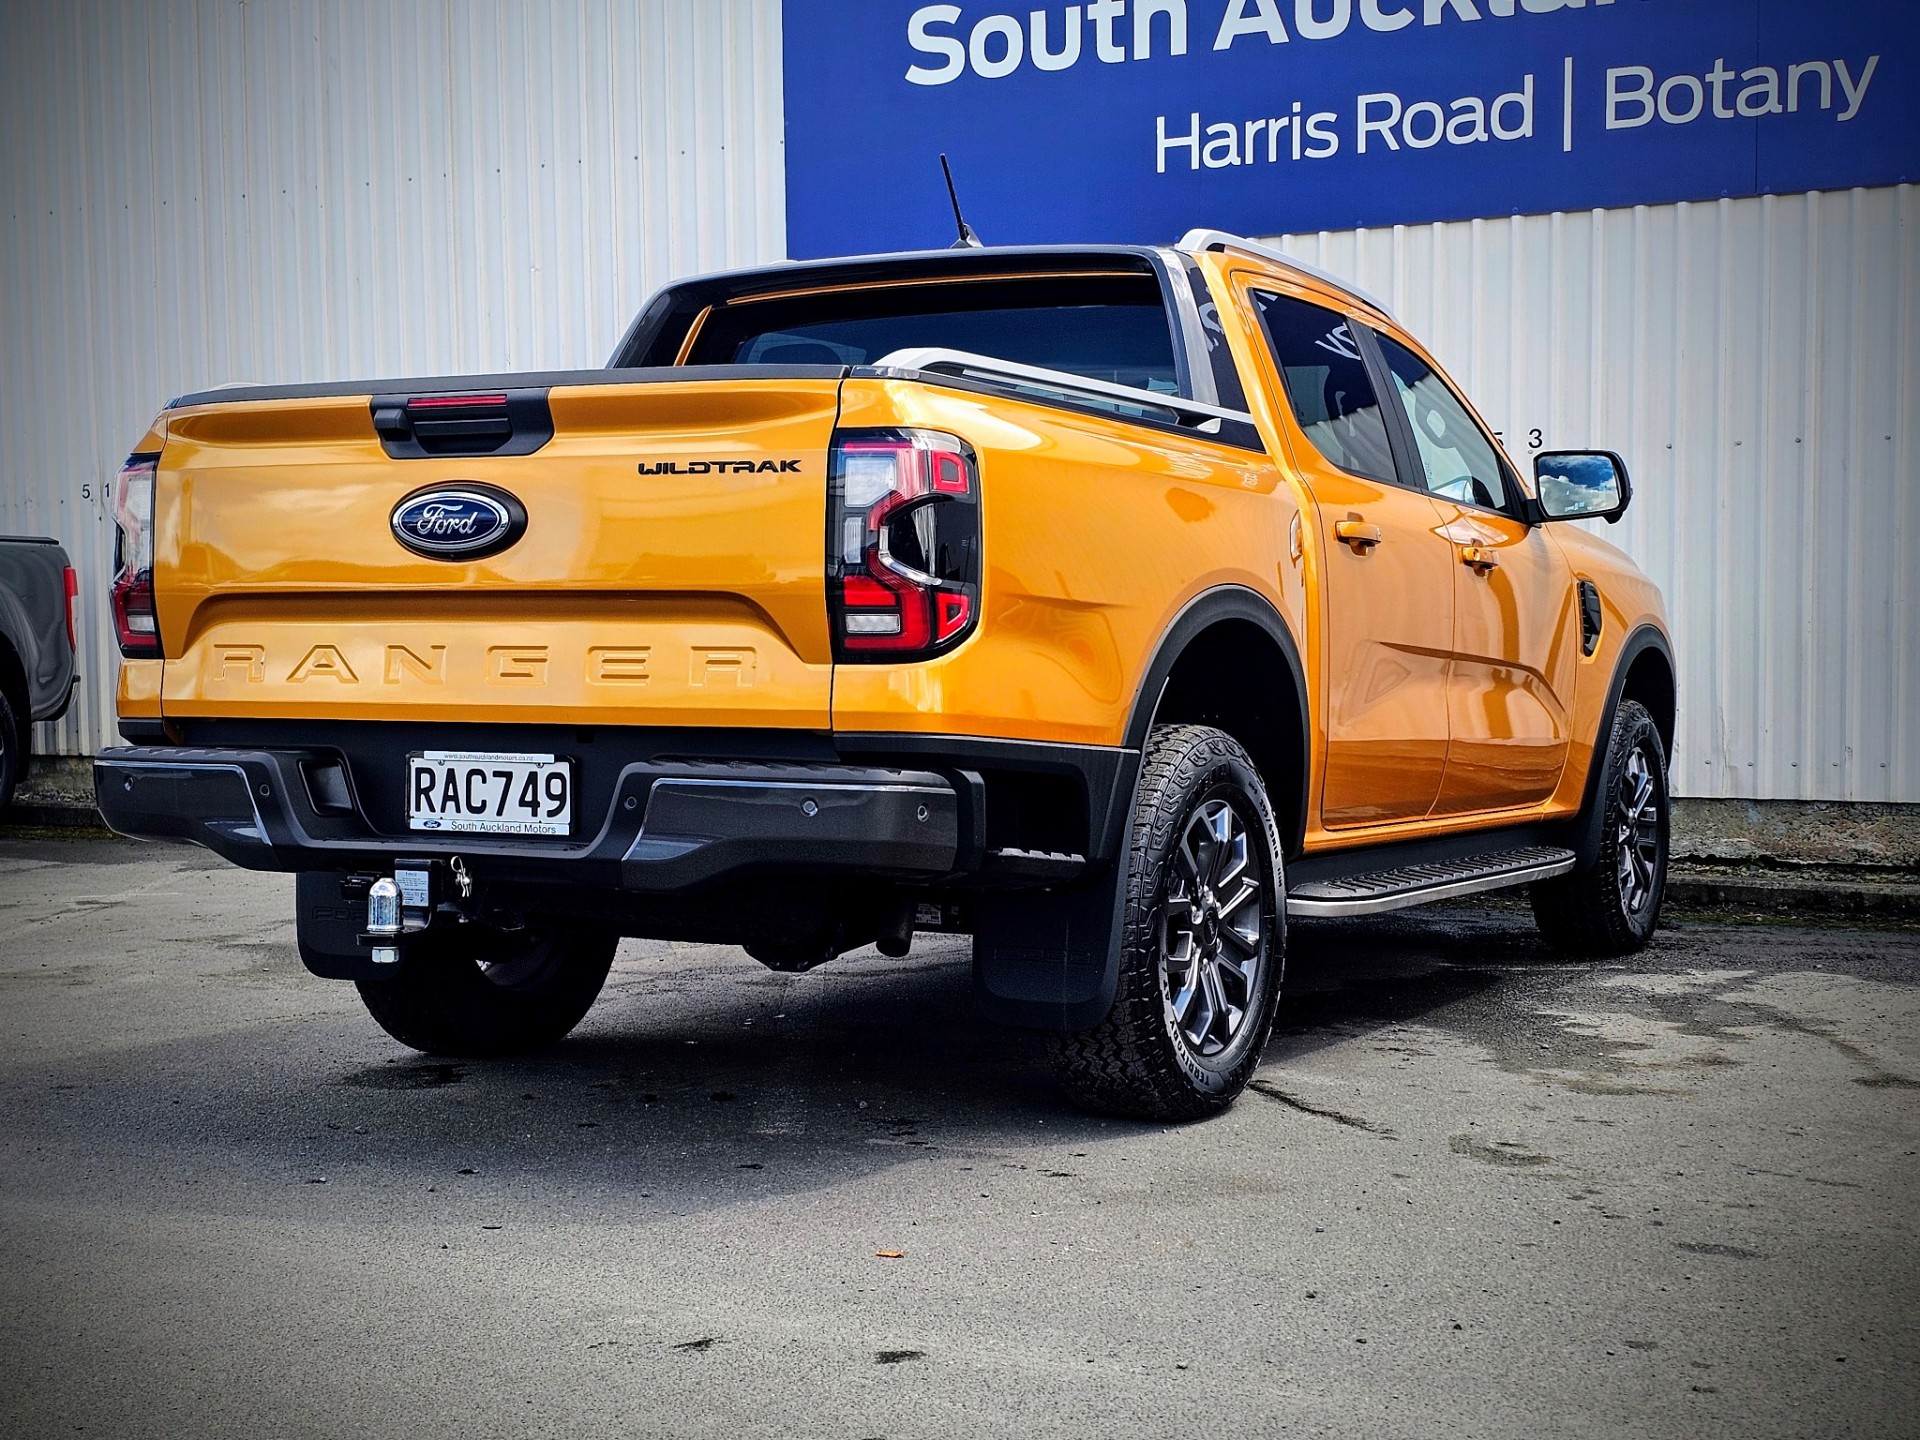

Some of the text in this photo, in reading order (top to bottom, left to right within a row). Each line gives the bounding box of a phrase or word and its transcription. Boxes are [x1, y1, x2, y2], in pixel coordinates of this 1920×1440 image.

[905, 0, 1186, 86] South
[1156, 55, 1880, 173] Harris Road Botany
[1528, 428, 1543, 449] 3
[638, 459, 802, 475] WILDTRAK
[82, 482, 110, 499] 5 1
[417, 503, 478, 535] Ford
[213, 643, 756, 687] RANGER
[414, 766, 567, 818] RAC749
[451, 820, 557, 834] South Auckland Motors
[1169, 1020, 1210, 1086] TERRITORY
